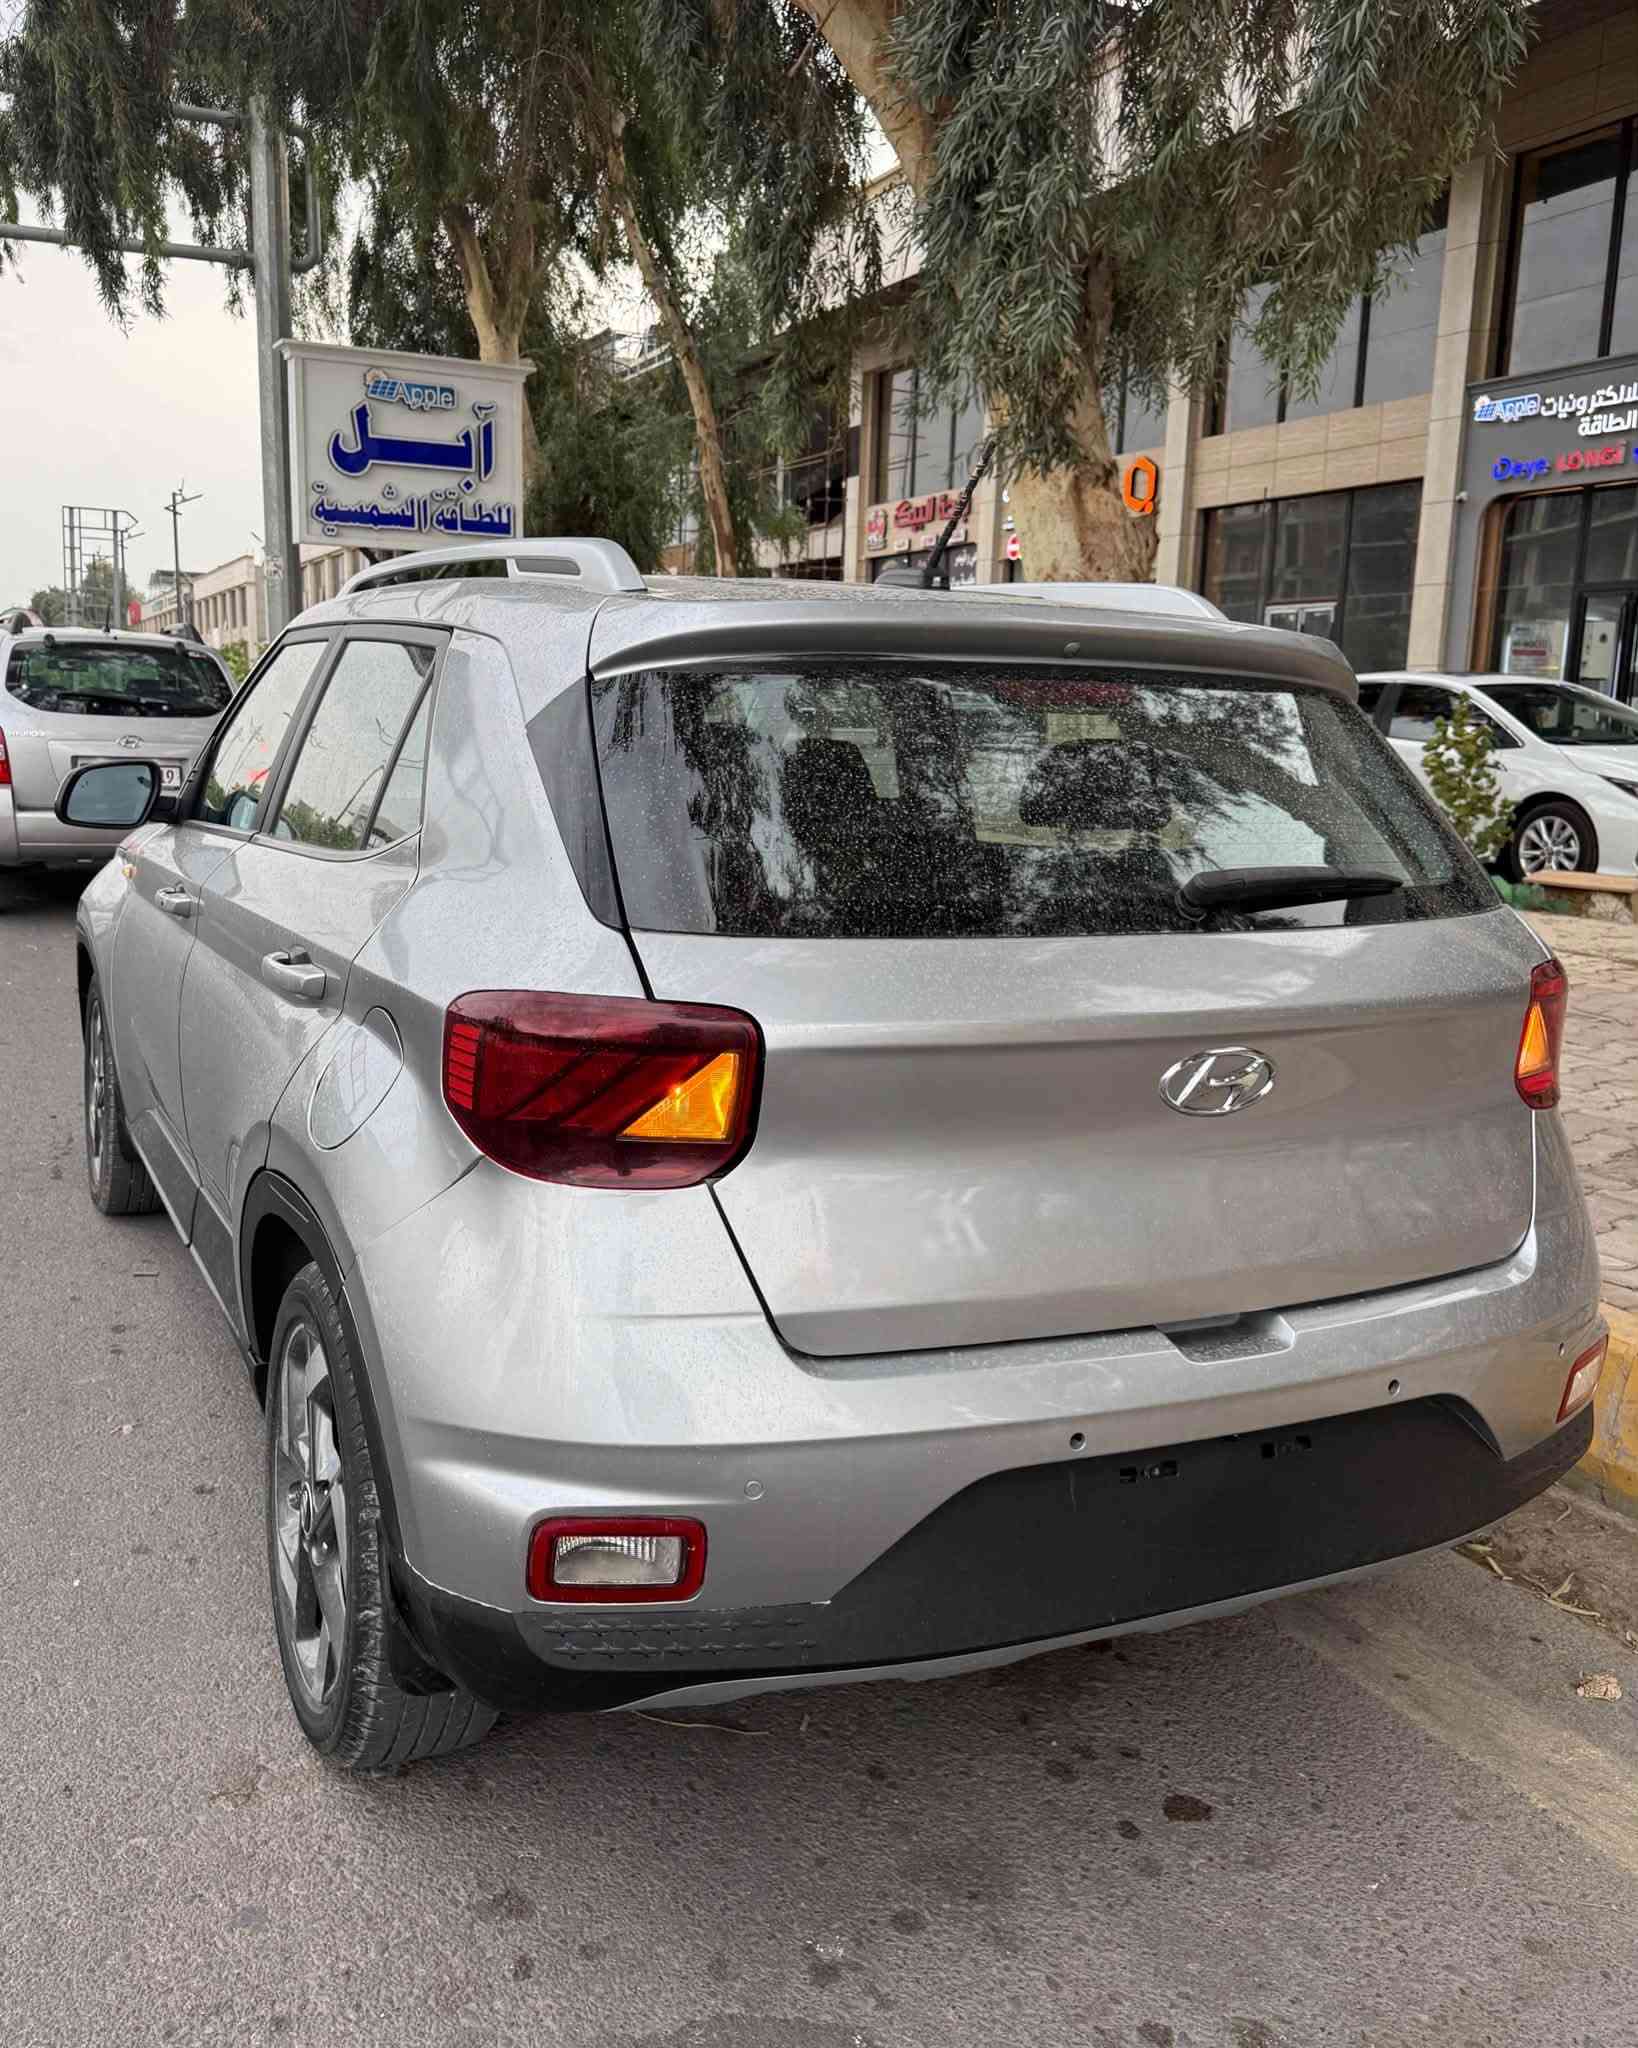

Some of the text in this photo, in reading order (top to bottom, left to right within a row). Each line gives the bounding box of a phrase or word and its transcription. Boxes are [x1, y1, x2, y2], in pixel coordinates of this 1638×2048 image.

[398, 382, 454, 409] Apple
[1495, 396, 1537, 421] Apple
[1541, 382, 1638, 419] لالكترونيات
[1578, 408, 1637, 436] الطاقة
[1492, 456, 1550, 480] Deye
[312, 481, 514, 537] للطاقة الشمسية
